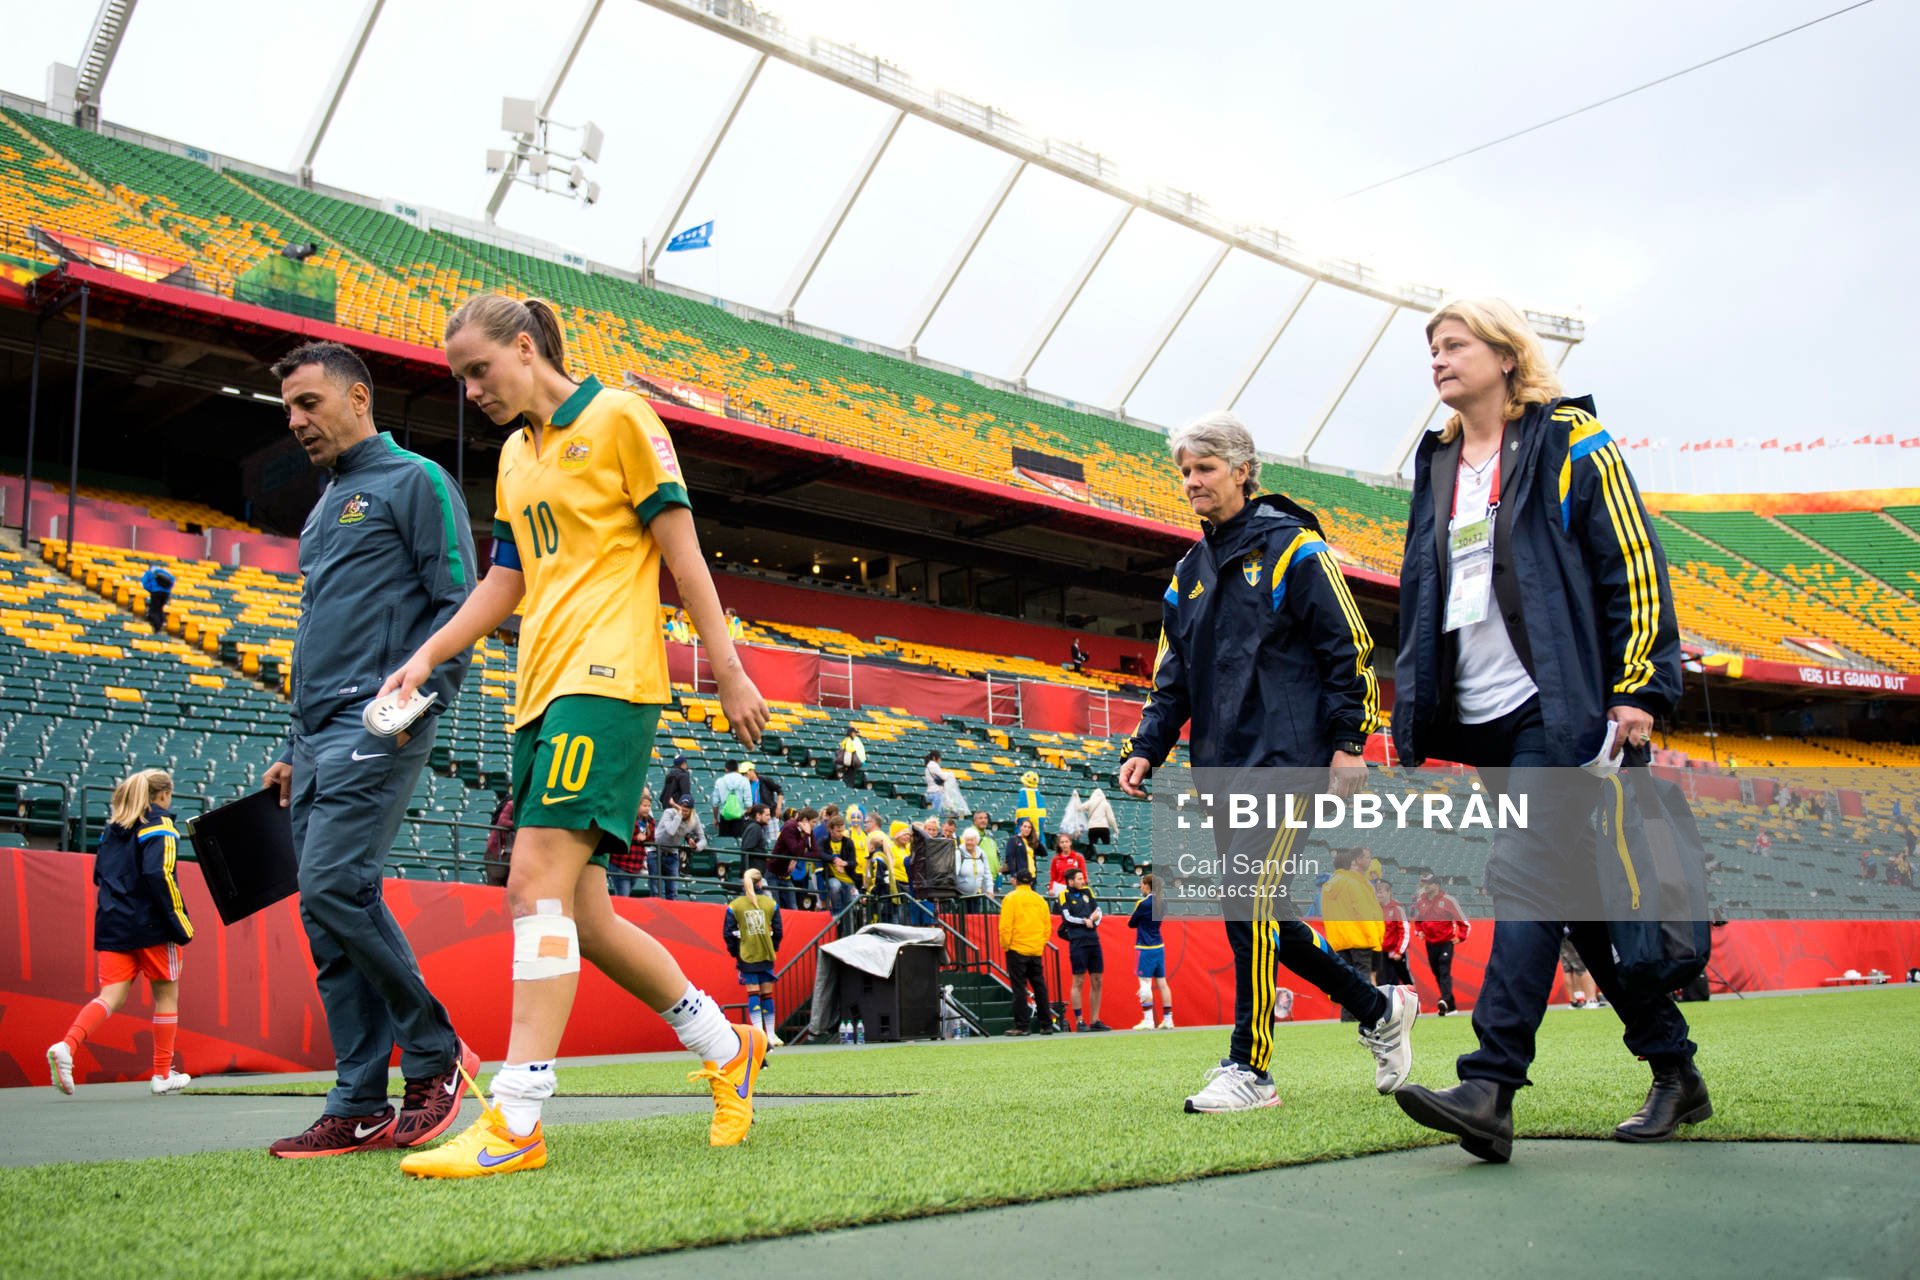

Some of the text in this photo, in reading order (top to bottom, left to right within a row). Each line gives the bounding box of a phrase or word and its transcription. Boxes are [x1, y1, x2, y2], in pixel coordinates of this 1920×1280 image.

[523, 500, 559, 559] 10
[1799, 668, 1906, 691] VERS LE GRAND BUT
[546, 733, 594, 792] 10
